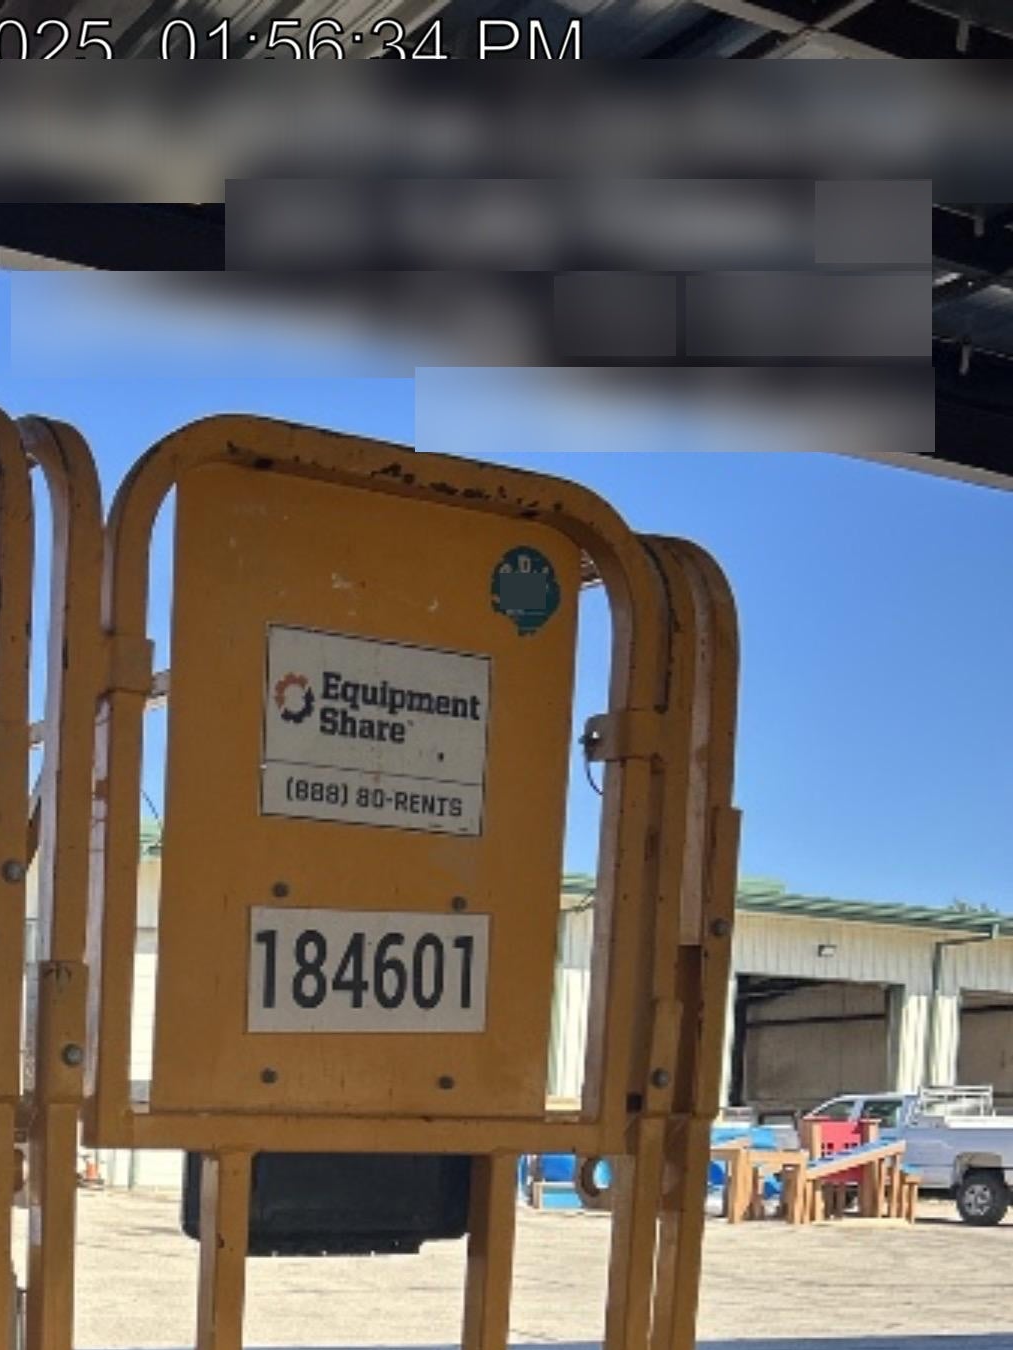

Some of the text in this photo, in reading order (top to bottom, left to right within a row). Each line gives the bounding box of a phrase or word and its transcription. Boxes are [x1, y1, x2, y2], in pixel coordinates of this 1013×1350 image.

[322, 671, 481, 720] Equipment
[319, 707, 406, 744] Share
[286, 776, 463, 818] (888) 80-RENTS
[255, 929, 474, 1010] 184601
